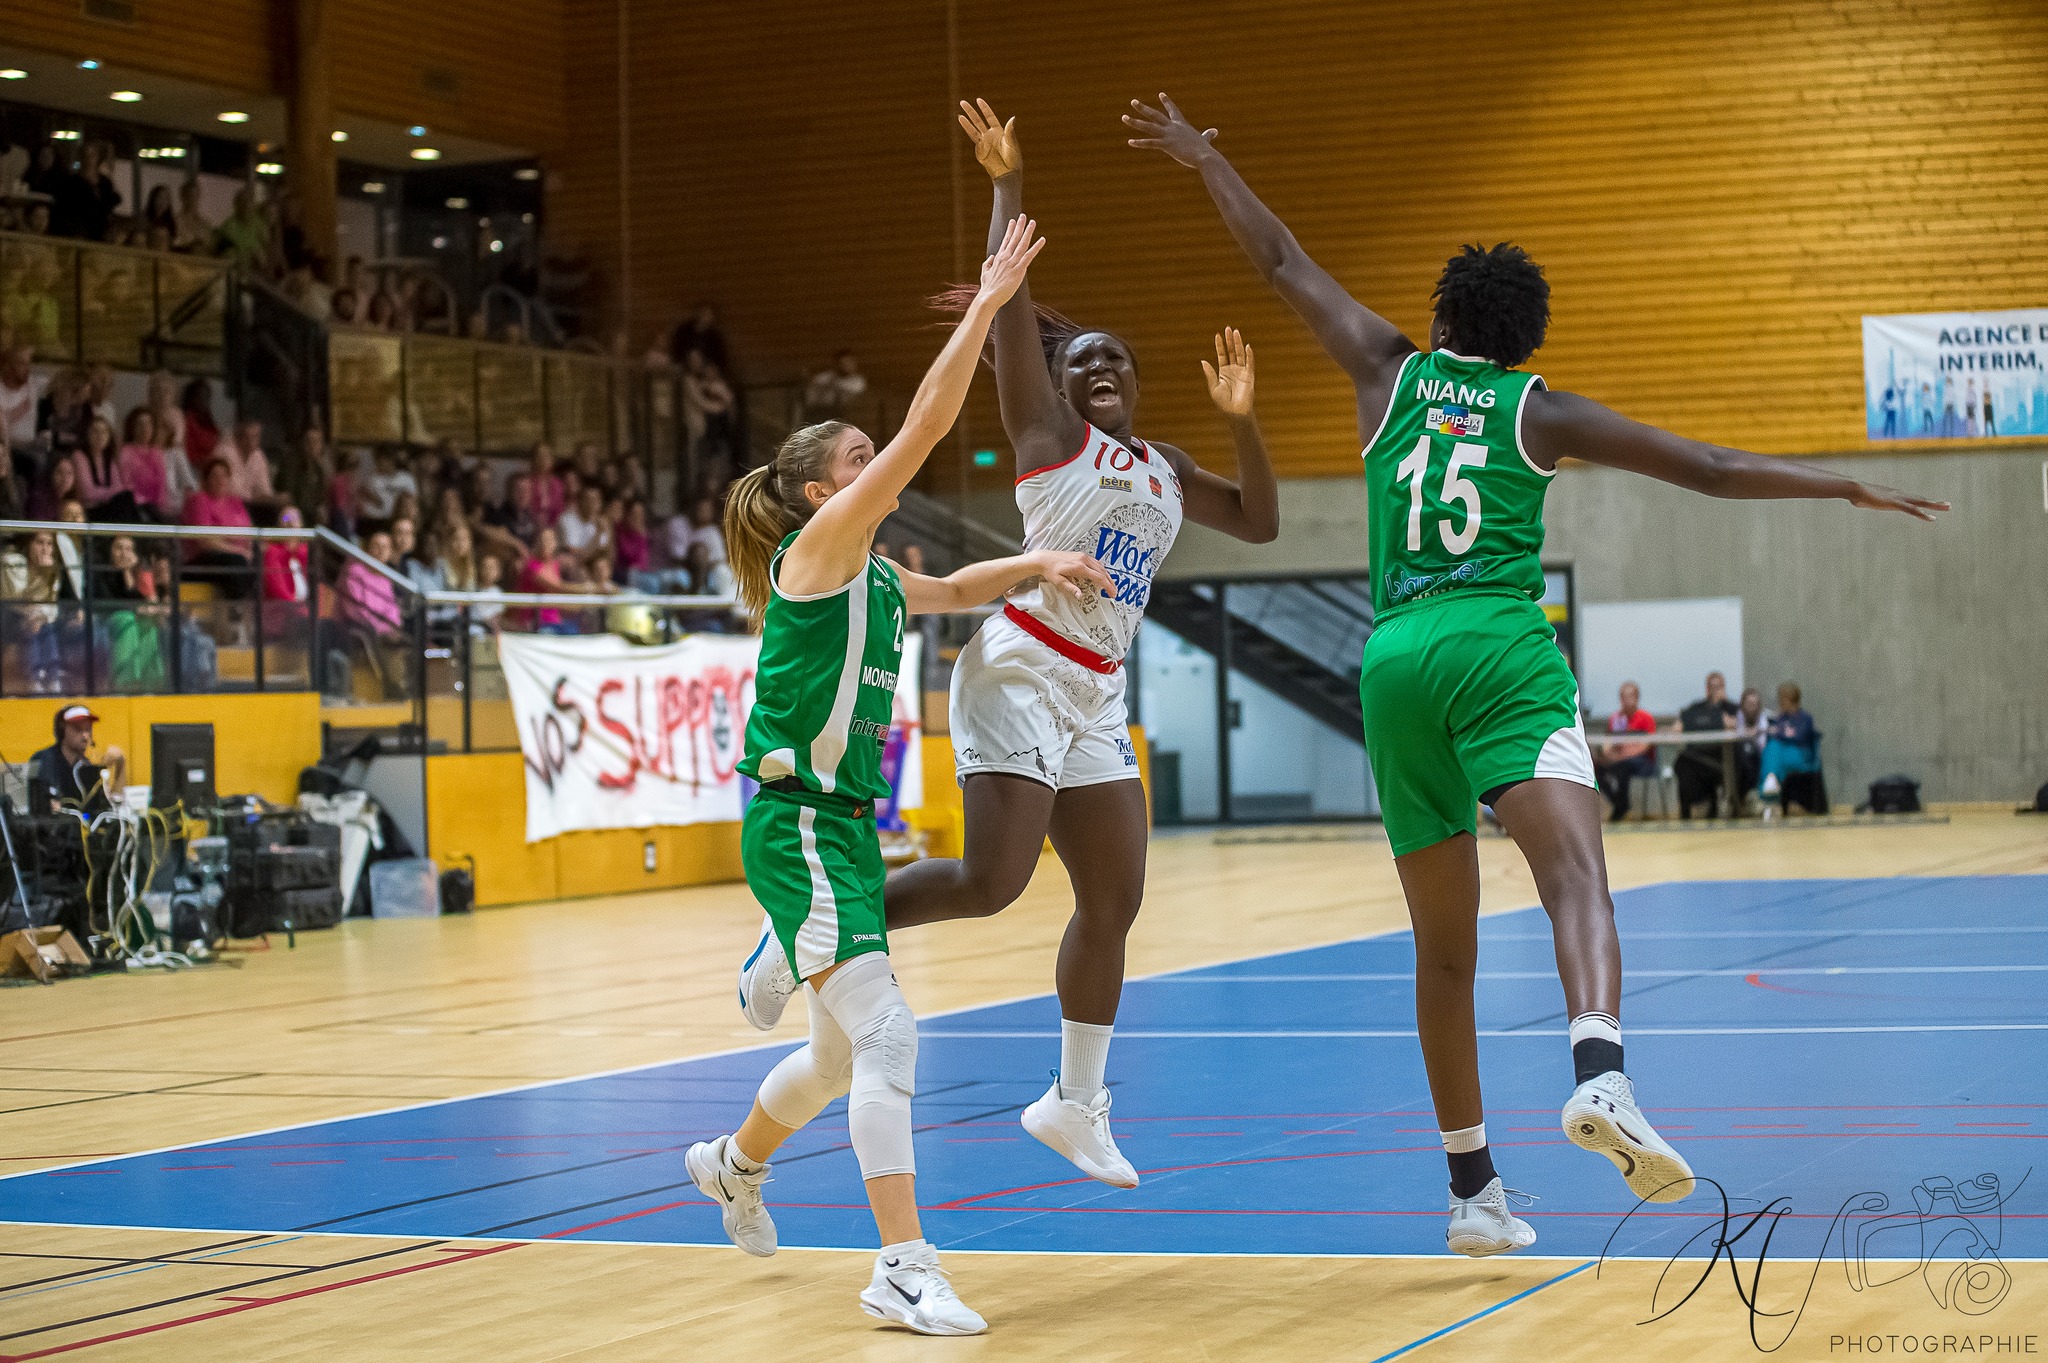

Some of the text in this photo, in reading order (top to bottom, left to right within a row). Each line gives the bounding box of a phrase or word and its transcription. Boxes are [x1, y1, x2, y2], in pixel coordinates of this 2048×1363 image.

[1939, 325, 2031, 345] AGENCE
[1939, 351, 2043, 372] INTERIM,
[1416, 379, 1496, 408] NIANG
[1429, 413, 1480, 428] agripax
[1094, 441, 1134, 472] 10
[1101, 475, 1131, 488] isère
[1396, 435, 1489, 555] 15
